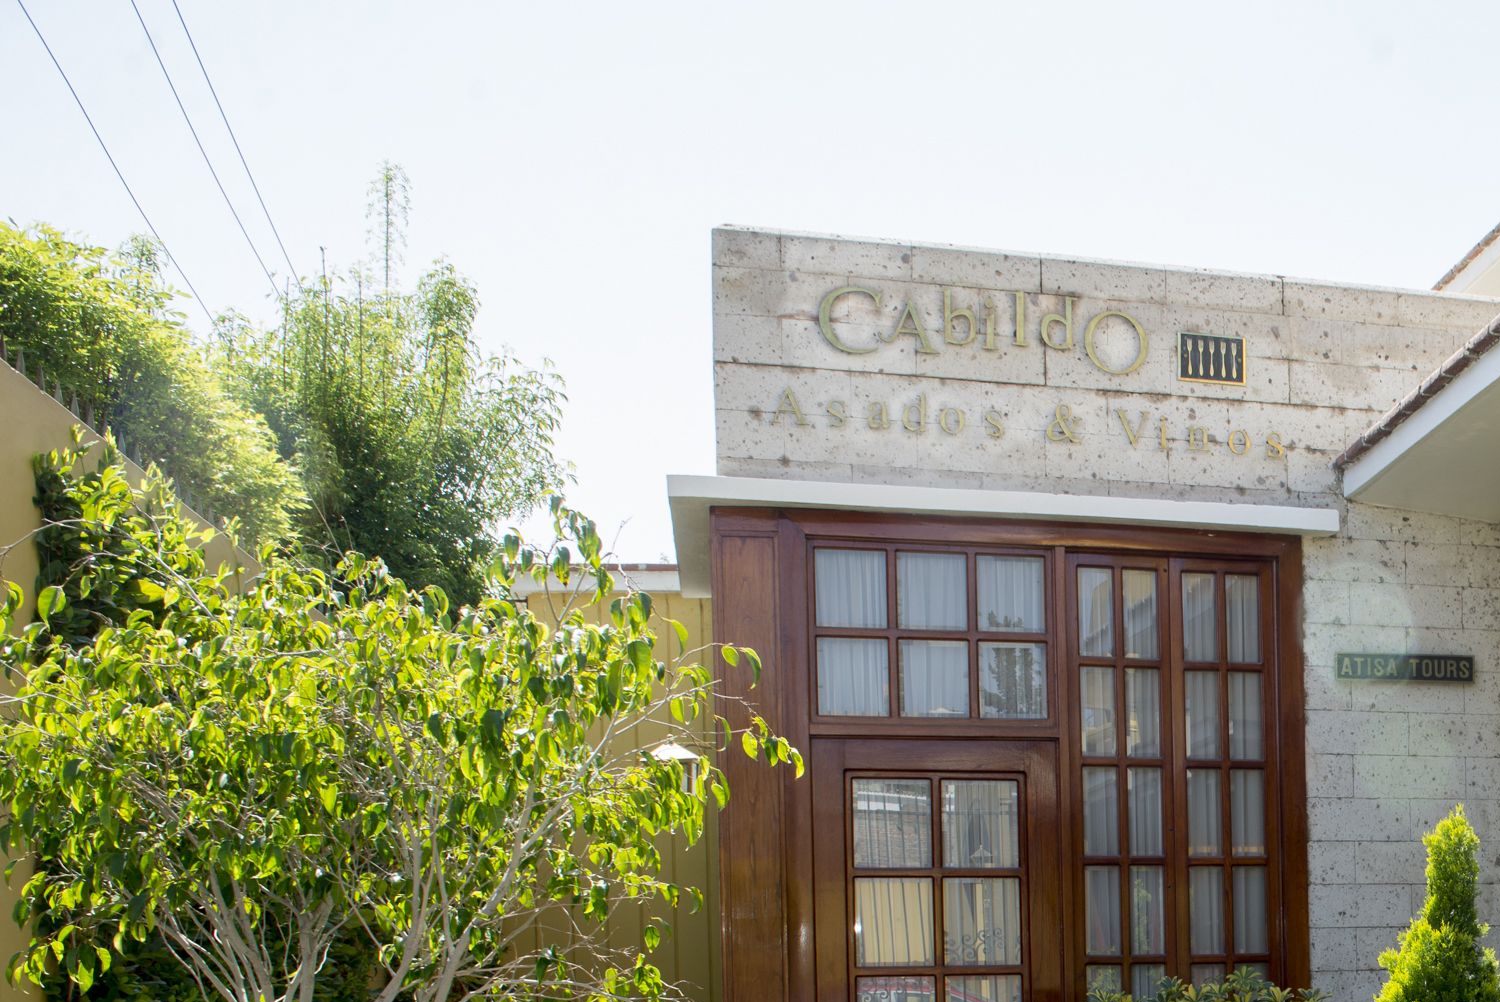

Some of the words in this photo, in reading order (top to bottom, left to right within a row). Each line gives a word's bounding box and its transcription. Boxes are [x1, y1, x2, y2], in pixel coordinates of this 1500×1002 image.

[773, 387, 1005, 439] Asados
[1046, 403, 1082, 444] &
[1115, 409, 1286, 460] Vinos
[1341, 657, 1398, 676] ATISA
[1409, 659, 1470, 678] TOURS
